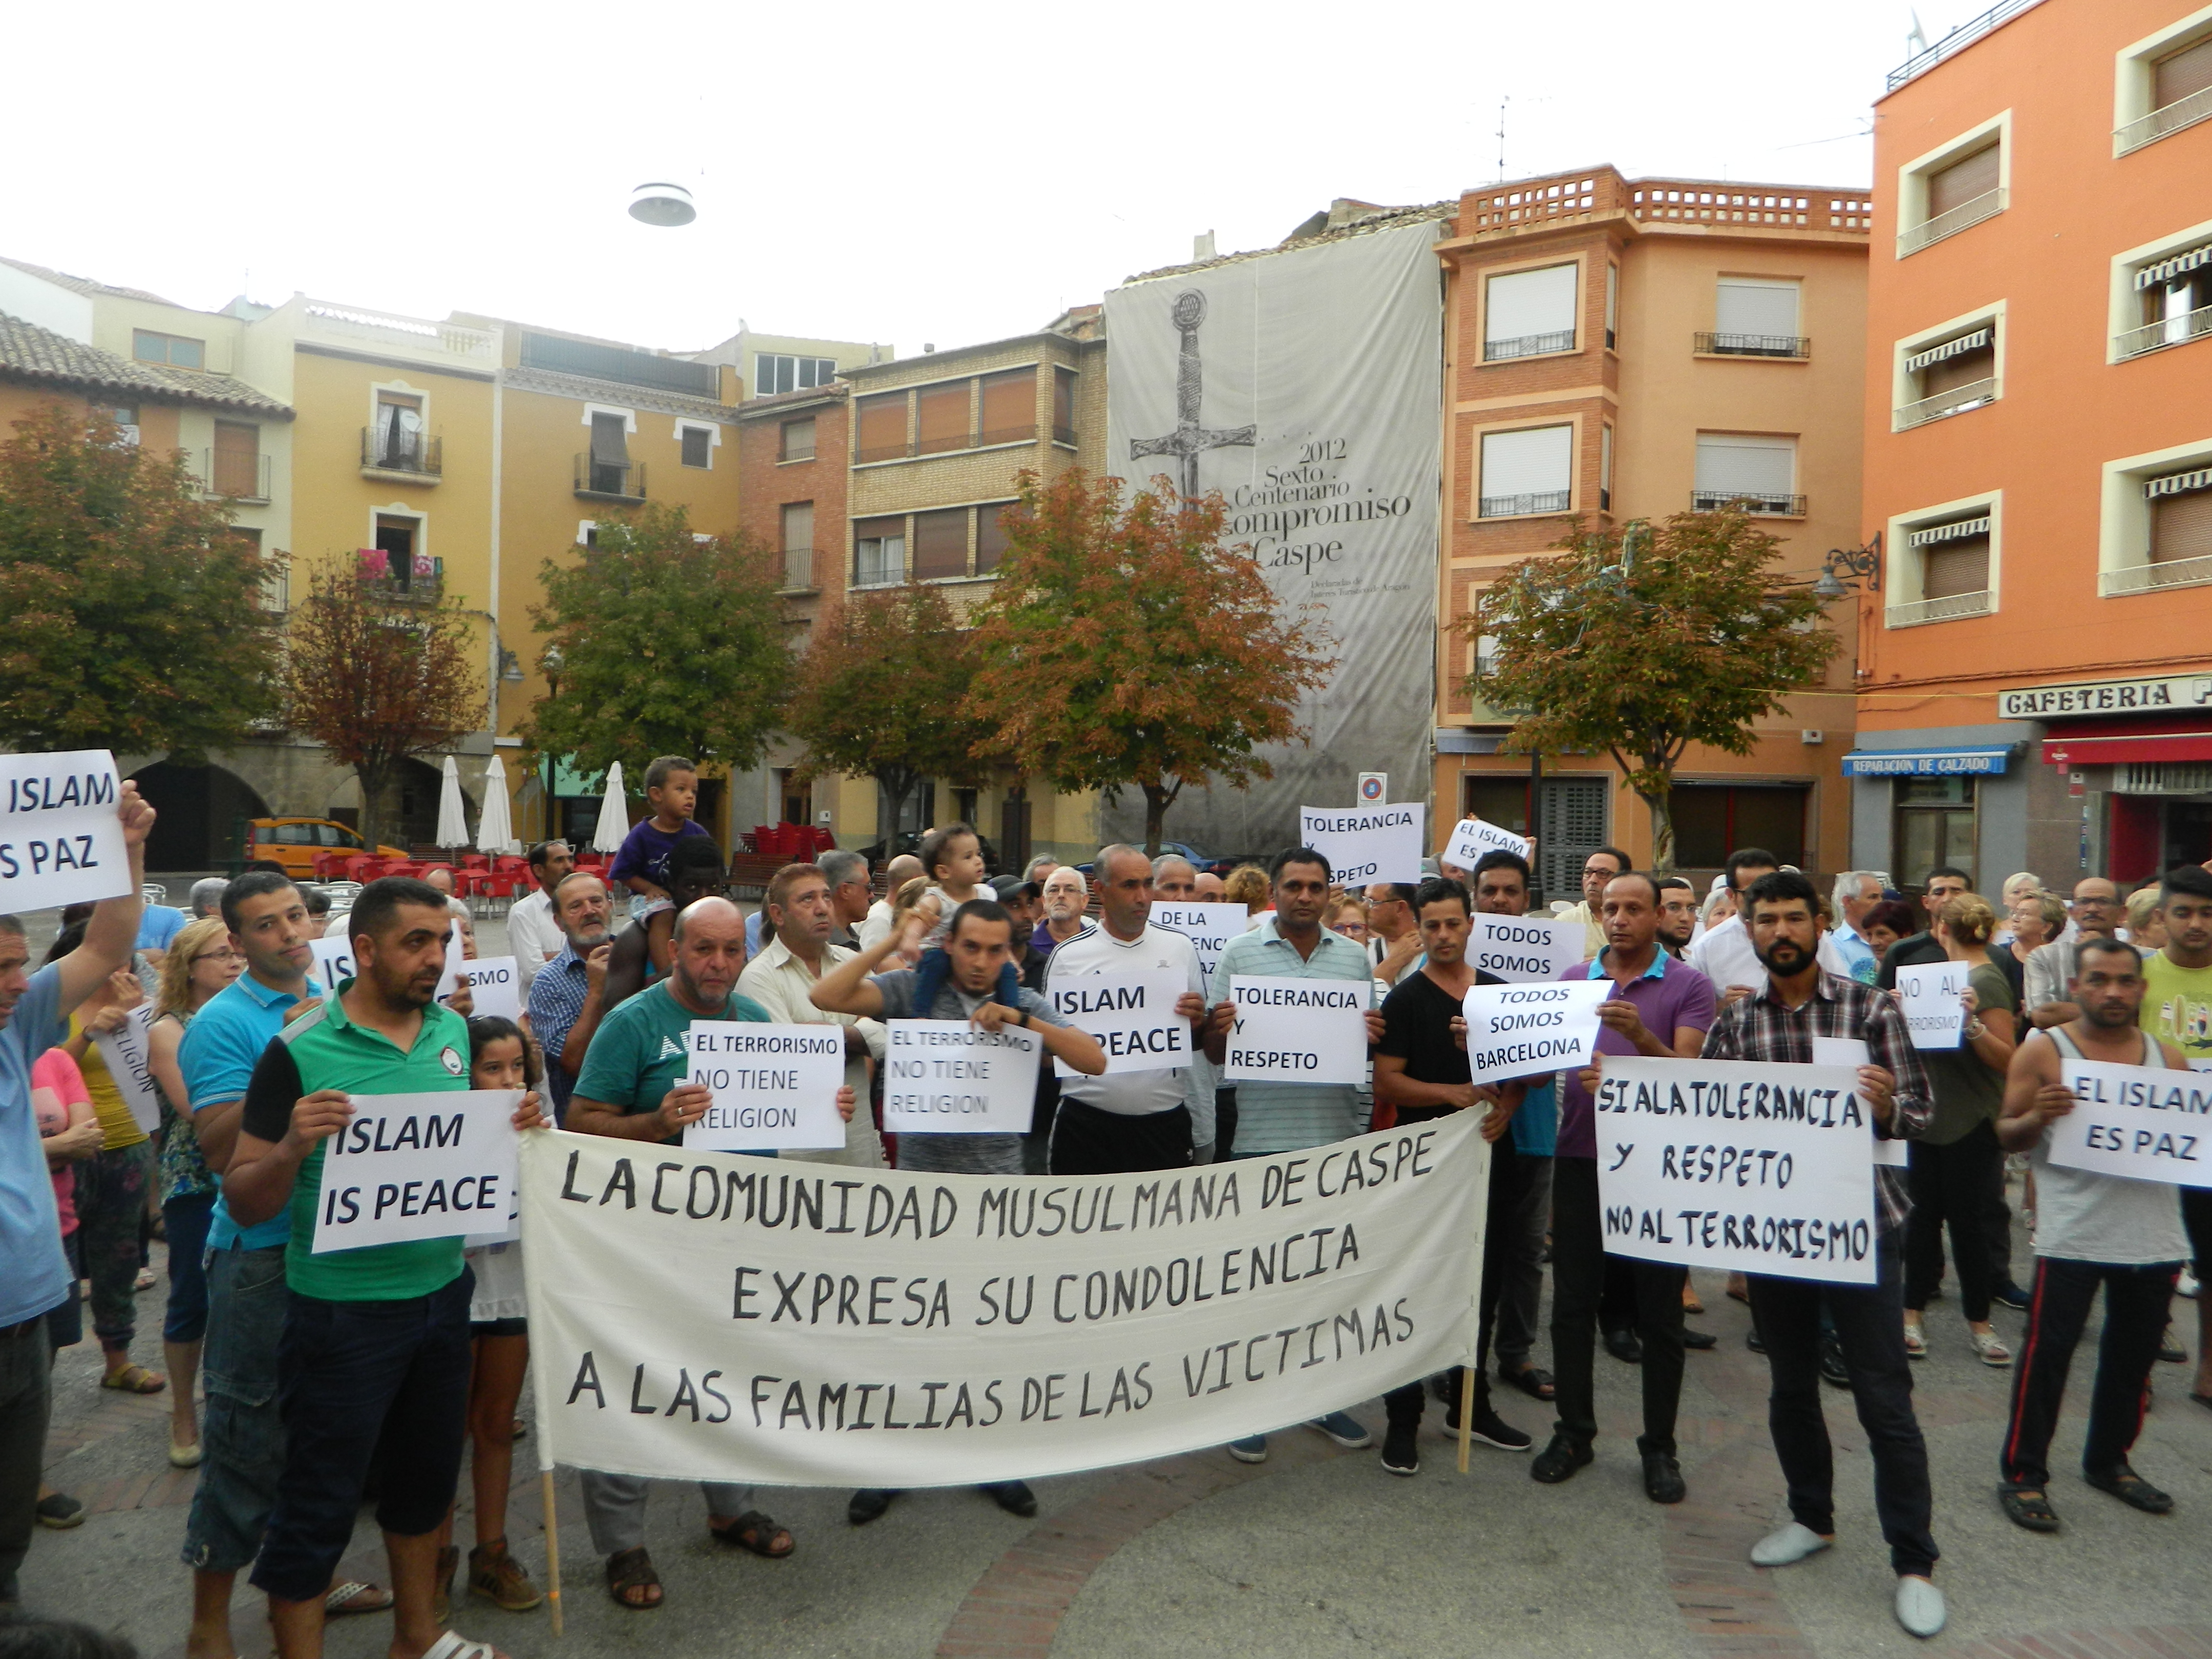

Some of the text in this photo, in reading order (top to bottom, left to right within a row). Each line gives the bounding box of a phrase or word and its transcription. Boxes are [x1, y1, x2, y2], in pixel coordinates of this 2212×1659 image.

[1299, 437, 1347, 464] 2012
[1264, 465, 1323, 488] Sexto
[1235, 476, 1349, 508] Centenario
[1223, 488, 1411, 542] ompromiso
[1253, 536, 1343, 575] Caspe
[2006, 683, 2172, 714] CAFETERIA
[1853, 757, 1989, 772] REPARACION DE CALZADO
[9, 773, 114, 813] ISLAM
[1304, 811, 1413, 833] TOLERANCIA
[1460, 823, 1524, 855] EL ISLAM
[1460, 844, 1477, 859] ES
[0, 834, 98, 878] S PAZ
[1328, 862, 1377, 883] SPETO
[1162, 911, 1206, 925] DE LA
[1485, 925, 1552, 946] TODOS
[1479, 952, 1551, 974] SOMOS
[468, 969, 509, 987] SMO
[1899, 975, 1959, 998] NO AL
[1055, 985, 1144, 1015] ISLAM
[1235, 987, 1358, 1009] TOLERANCIA
[1499, 988, 1570, 1004] TODOS
[1235, 1018, 1246, 1035] Y
[1490, 1011, 1564, 1034] SOMOS
[1907, 1015, 1959, 1031] RRORISMO
[697, 1034, 838, 1054] EL TERRORISMO
[893, 1031, 1033, 1053] EL TERRORISMO
[1095, 1027, 1181, 1056] PEACE
[1476, 1037, 1581, 1070] BARCELONA
[112, 1029, 154, 1093] ELIGION
[891, 1060, 991, 1080] NO TIENE
[1231, 1049, 1318, 1070] RESPETO
[695, 1069, 730, 1090] NO
[737, 1069, 799, 1091] TIENE
[889, 1094, 990, 1115] RELIGION
[1598, 1078, 1630, 1113] SI
[1690, 1080, 1862, 1128] TOLERANCIA
[2075, 1075, 2212, 1115] EL ISLAM
[693, 1107, 797, 1129] RELIGION
[335, 1113, 464, 1155] ISLAM
[2086, 1124, 2199, 1161] ES PAZ
[1609, 1142, 1793, 1189] Y RESPETO
[560, 1150, 636, 1210] LA
[652, 1162, 958, 1241] COMUNIDAD
[976, 1172, 1241, 1241] MUSULMANA
[1261, 1158, 1310, 1210] DE
[1317, 1130, 1438, 1198] CASPE
[325, 1186, 360, 1226] IS
[374, 1175, 499, 1220] PEACE
[1606, 1205, 1869, 1261] NO AL TERRORISMO
[733, 1223, 1359, 1329] EXPRESA SU CONDOLENCIA
[566, 1297, 1415, 1432] A LAS FAMILIAS DE LAS VICTIMAS
